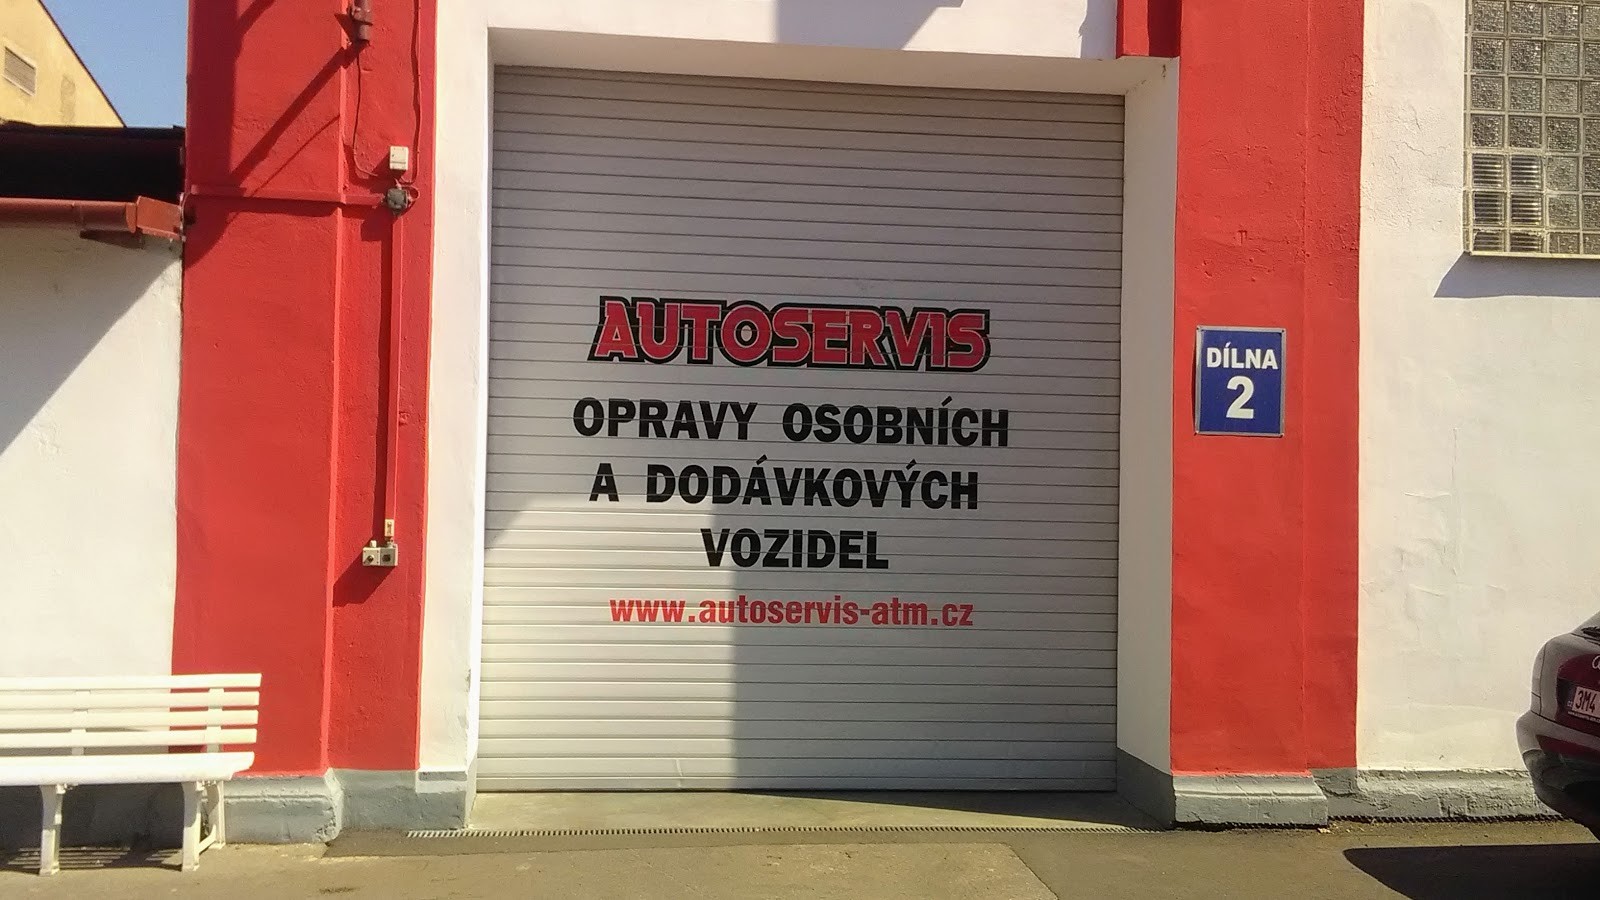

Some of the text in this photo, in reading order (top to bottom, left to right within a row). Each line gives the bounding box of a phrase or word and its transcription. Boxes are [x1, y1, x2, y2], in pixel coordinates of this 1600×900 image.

[588, 296, 991, 371] AUTOSERVIS
[1206, 341, 1278, 370] DÍLNA
[1226, 375, 1255, 419] 2
[573, 396, 1009, 447] OPRAVY OSOBNÍCH
[589, 454, 978, 509] A DODÁVKOVÝCH
[700, 528, 889, 569] VOZIDEL
[610, 595, 974, 626] www.autoservis-atm.cz
